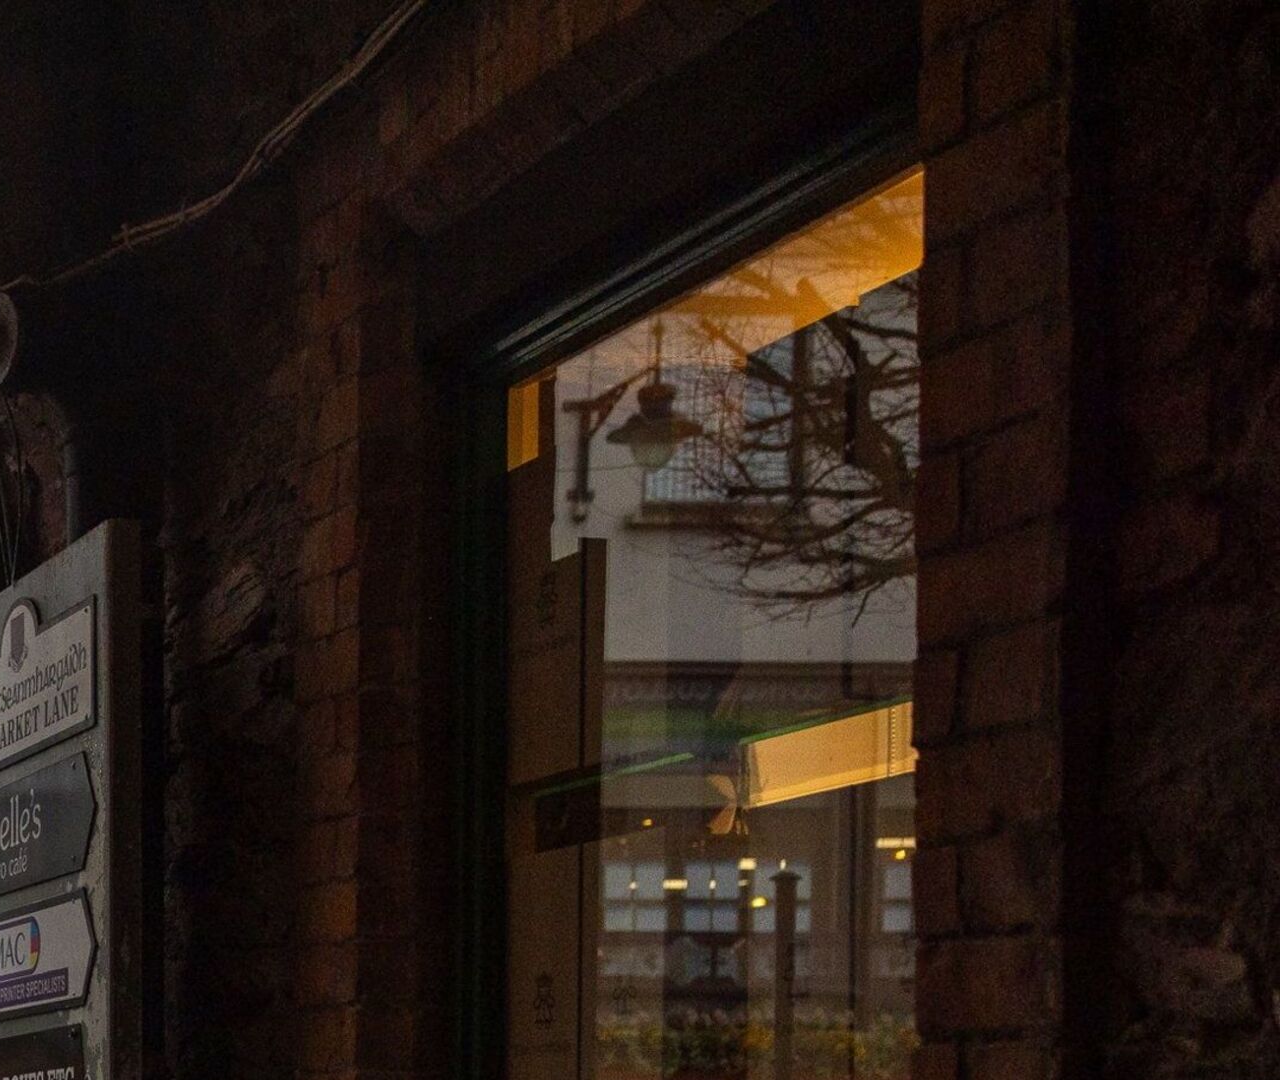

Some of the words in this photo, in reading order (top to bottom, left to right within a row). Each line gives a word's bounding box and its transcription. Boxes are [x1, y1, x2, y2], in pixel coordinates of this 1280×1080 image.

[44, 683, 80, 731] LANE
[0, 984, 25, 1004] PRINTER
[26, 975, 67, 998] SPECIALISTS
